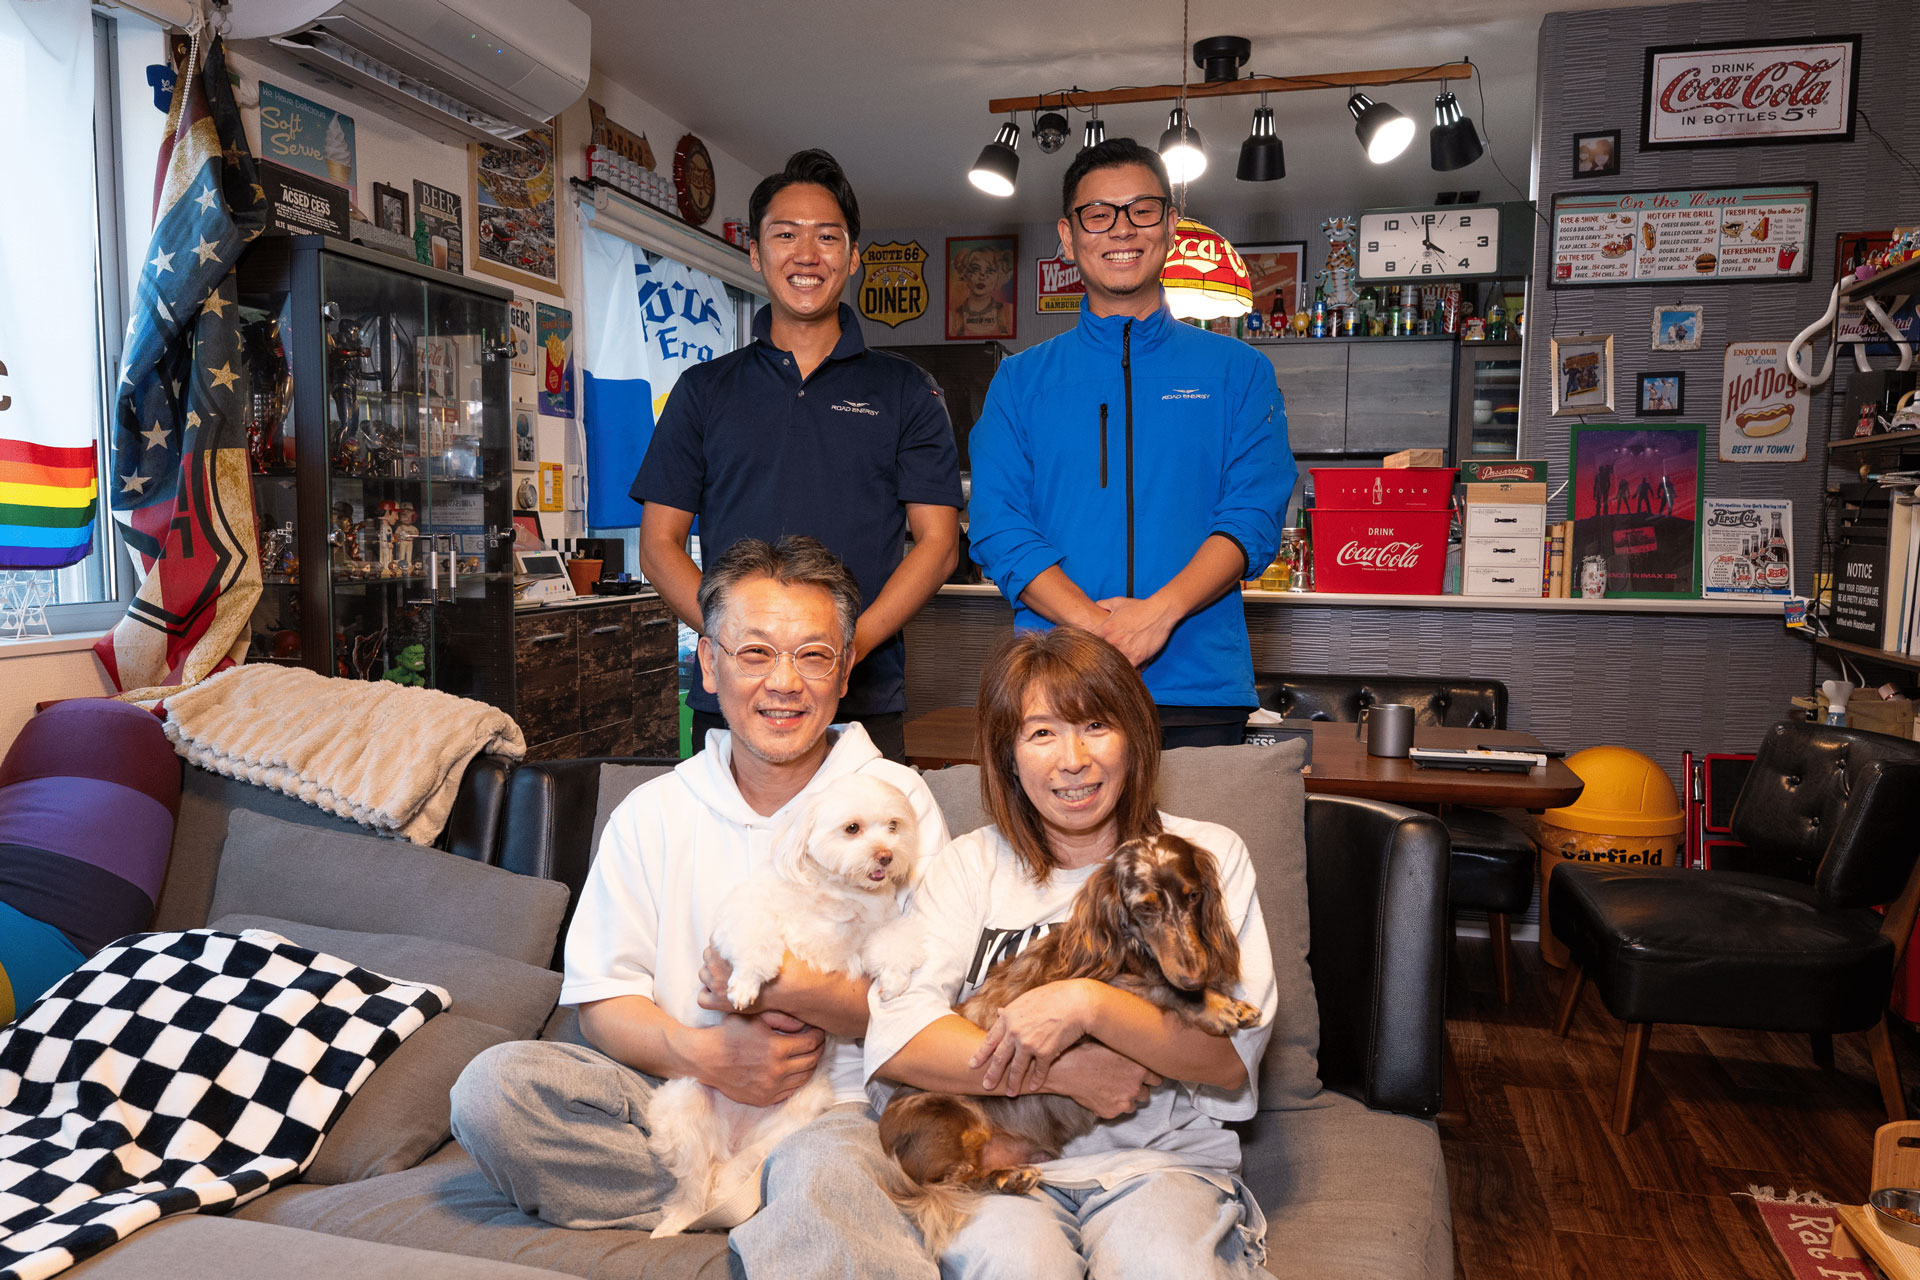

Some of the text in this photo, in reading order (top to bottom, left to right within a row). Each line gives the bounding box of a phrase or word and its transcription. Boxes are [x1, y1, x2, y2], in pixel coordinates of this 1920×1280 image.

[1712, 62, 1755, 74] DRINK
[1660, 58, 1841, 114] Coca-Cola
[262, 87, 326, 119] We Have Delicious
[1681, 107, 1818, 126] IN BOTTLES 5¢
[261, 107, 303, 140] Soft
[271, 133, 324, 160] Serve
[282, 188, 310, 208] ACSED
[311, 198, 331, 216] CESS
[422, 184, 456, 216] BEER
[1620, 192, 1739, 209] On the Menu
[1460, 216, 1471, 227] 2
[1647, 212, 1661, 220] HOT
[1384, 220, 1399, 231] 10
[1368, 241, 1379, 252] 9
[1477, 236, 1489, 248] 3
[868, 248, 920, 261] ROUTE 66
[1722, 246, 1776, 255] REFRESHMENTS
[1385, 261, 1396, 272] 8
[1422, 264, 1432, 274] 6
[1458, 258, 1470, 268] 4
[872, 266, 916, 280] LAST CHANCE
[865, 286, 921, 314] DINER
[510, 307, 530, 334] GERS
[1840, 324, 1869, 336] Have
[1869, 324, 1879, 334] a
[1733, 348, 1759, 356] ENJOY
[1746, 356, 1778, 366] Delicious
[1732, 444, 1795, 454] BEST IN TOWN!
[1368, 528, 1394, 536] DRINK
[1336, 540, 1424, 568] Coca-Cola
[1846, 562, 1873, 579] NOTICE
[1560, 842, 1662, 866] Garfield
